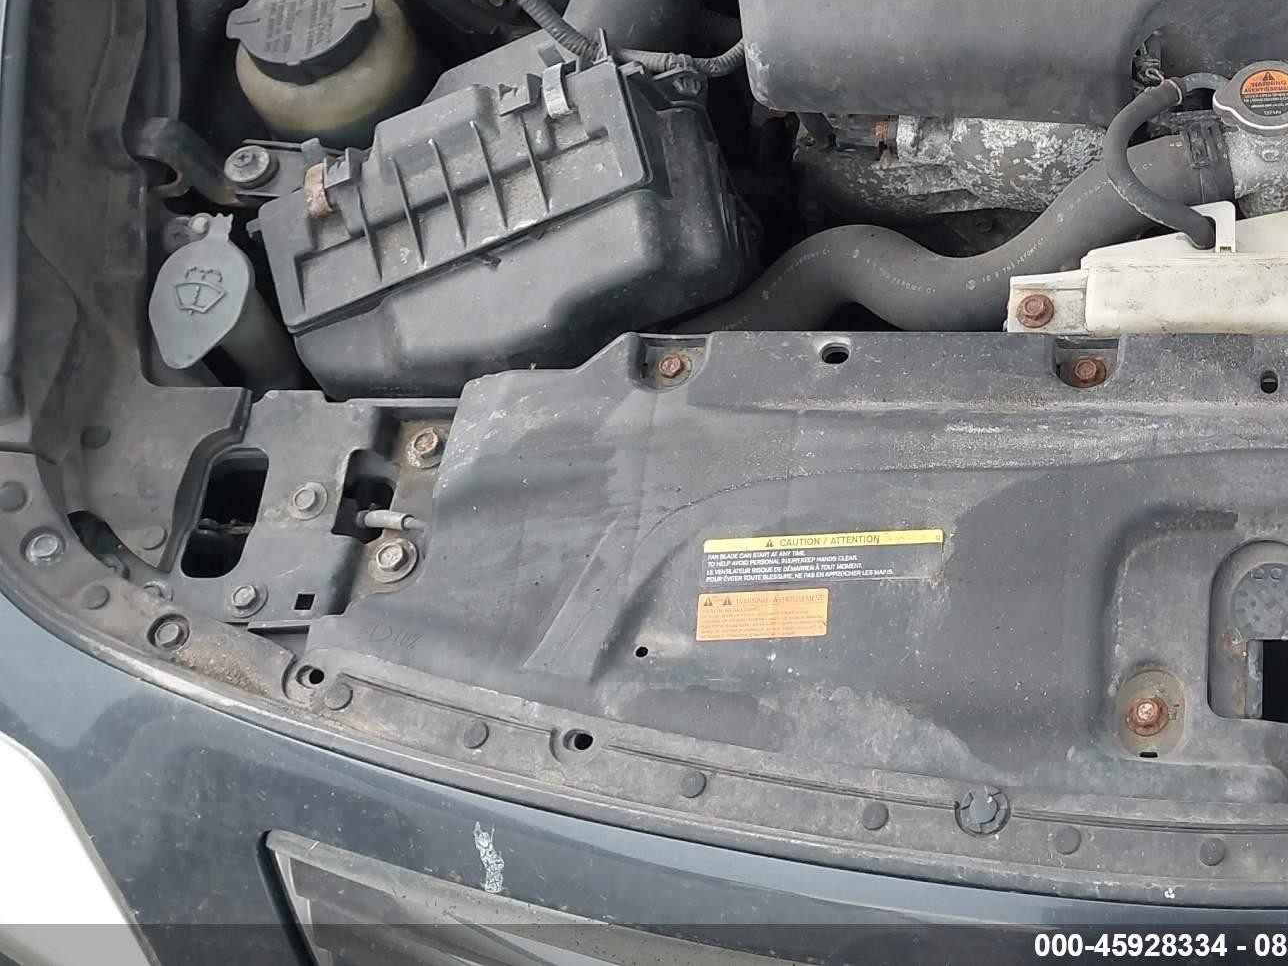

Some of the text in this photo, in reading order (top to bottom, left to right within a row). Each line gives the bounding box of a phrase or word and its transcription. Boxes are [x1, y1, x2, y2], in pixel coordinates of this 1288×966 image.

[1250, 80, 1287, 88] WARNING
[779, 537, 820, 547] CAUTION
[830, 535, 880, 545] ATTENTION
[749, 557, 780, 565] PERSONAL
[820, 563, 836, 571] TOUT
[743, 573, 761, 581] TOUTE
[795, 571, 803, 579] NE
[815, 570, 825, 578] EN
